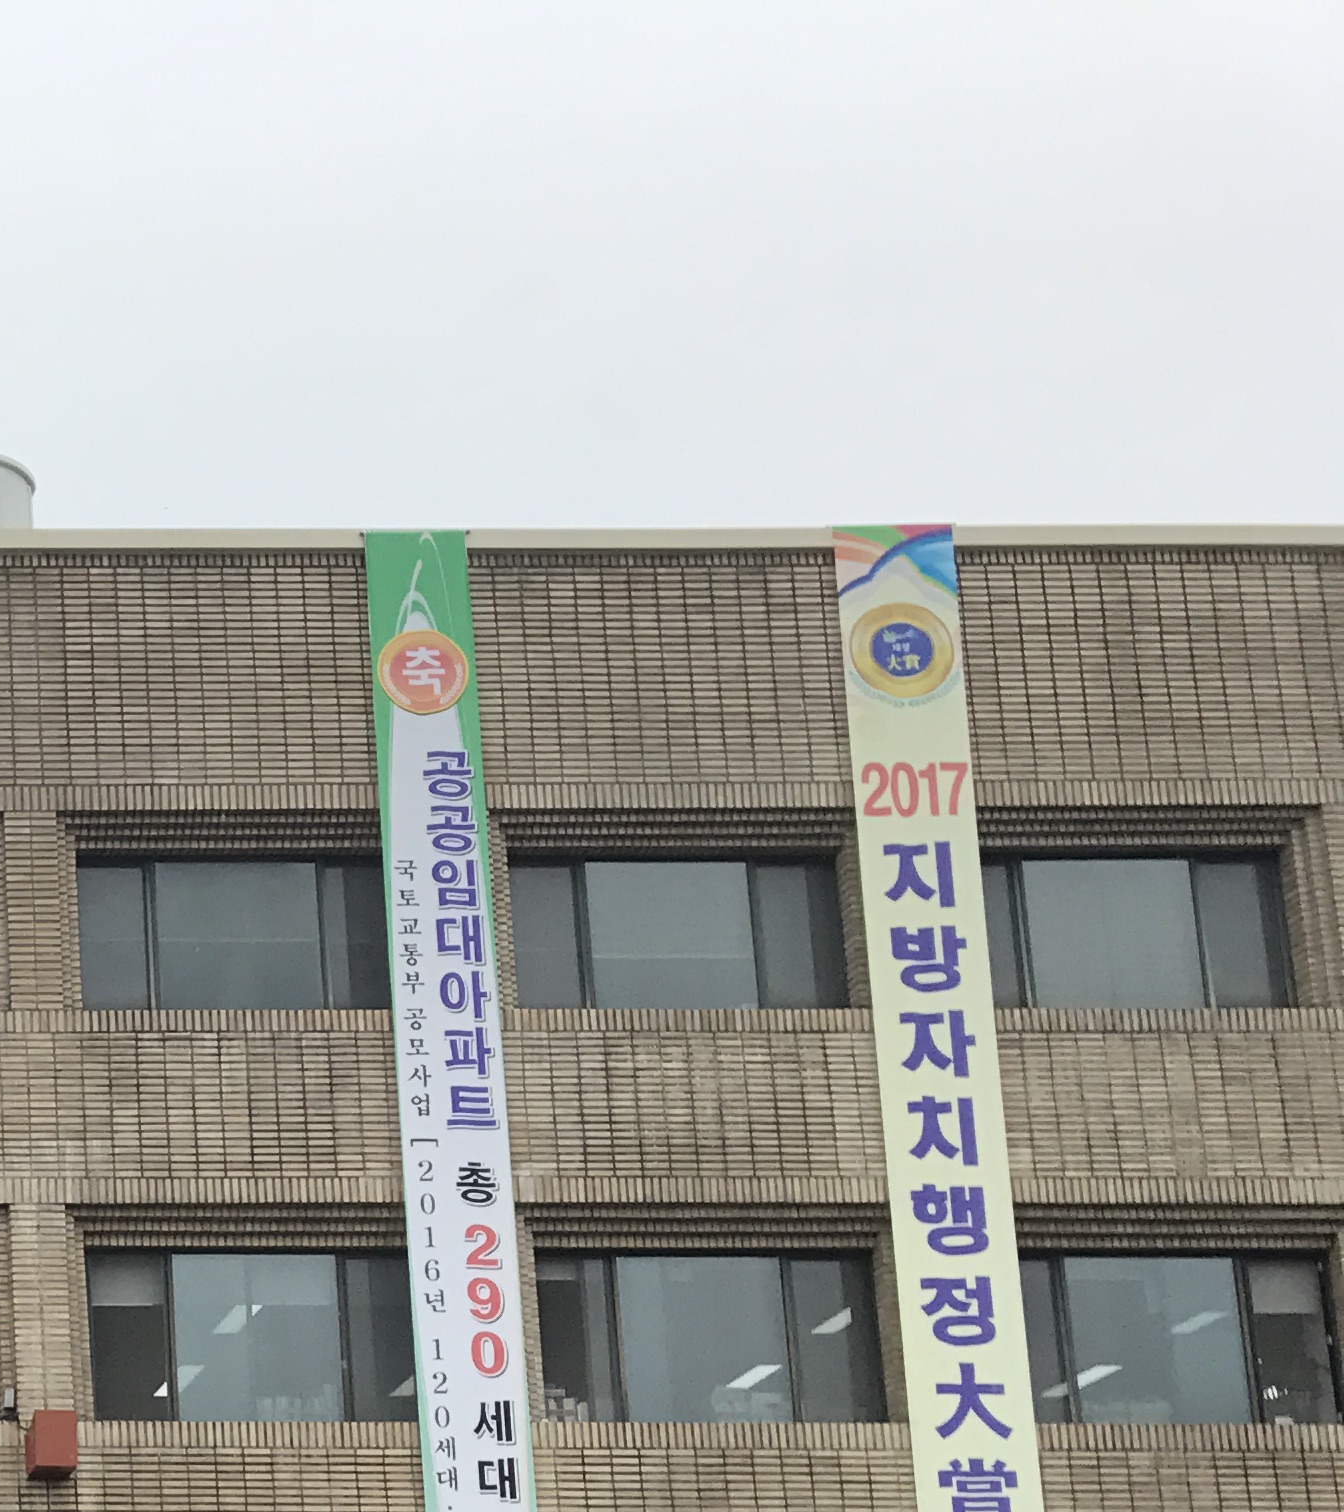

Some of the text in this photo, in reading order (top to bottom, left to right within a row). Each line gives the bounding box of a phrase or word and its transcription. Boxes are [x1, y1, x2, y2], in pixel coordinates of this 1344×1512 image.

[401, 646, 446, 696] 축
[860, 761, 968, 818] 2017
[393, 859, 426, 995] 국토교통부
[422, 750, 499, 1128] 공공임대아파트
[403, 1007, 433, 1117] 공모사업
[455, 1161, 497, 1204] 총
[464, 1223, 507, 1376] 290
[473, 1400, 518, 1501] 세대
